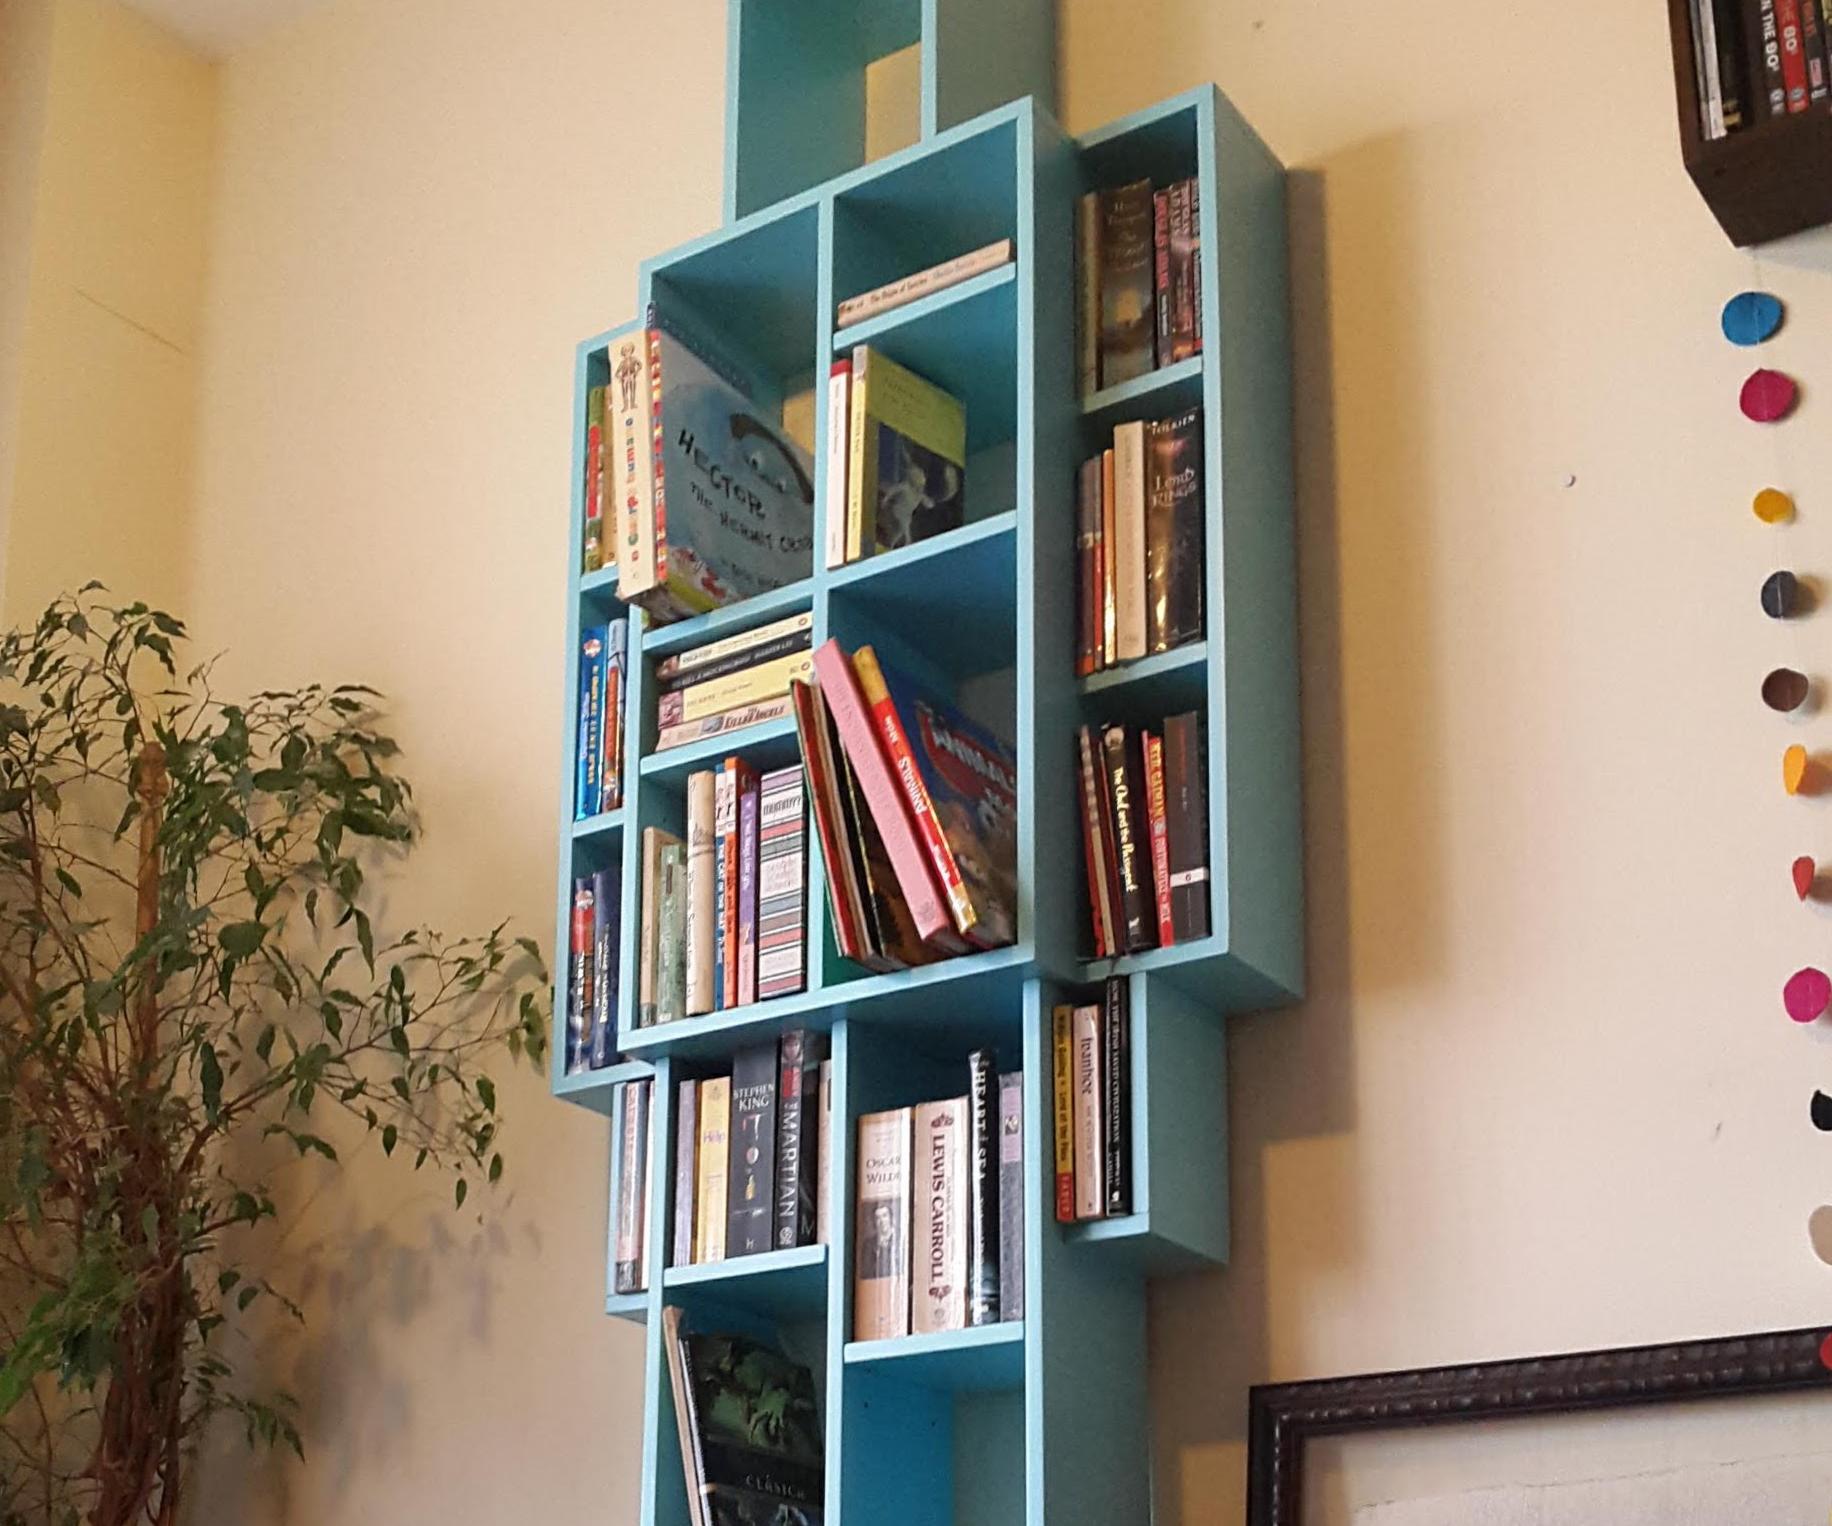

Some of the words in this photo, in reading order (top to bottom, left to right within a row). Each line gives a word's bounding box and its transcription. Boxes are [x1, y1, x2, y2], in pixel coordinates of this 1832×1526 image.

[678, 429, 766, 520] HECTOR
[899, 756, 927, 814] ANIMALS
[733, 1083, 775, 1099] STEPHEN
[738, 1097, 770, 1112] KING
[779, 1110, 799, 1217] MARTIAN
[866, 1156, 901, 1168] OSCAR
[931, 1134, 945, 1194] LEWIS
[931, 1197, 945, 1283] CARROLL
